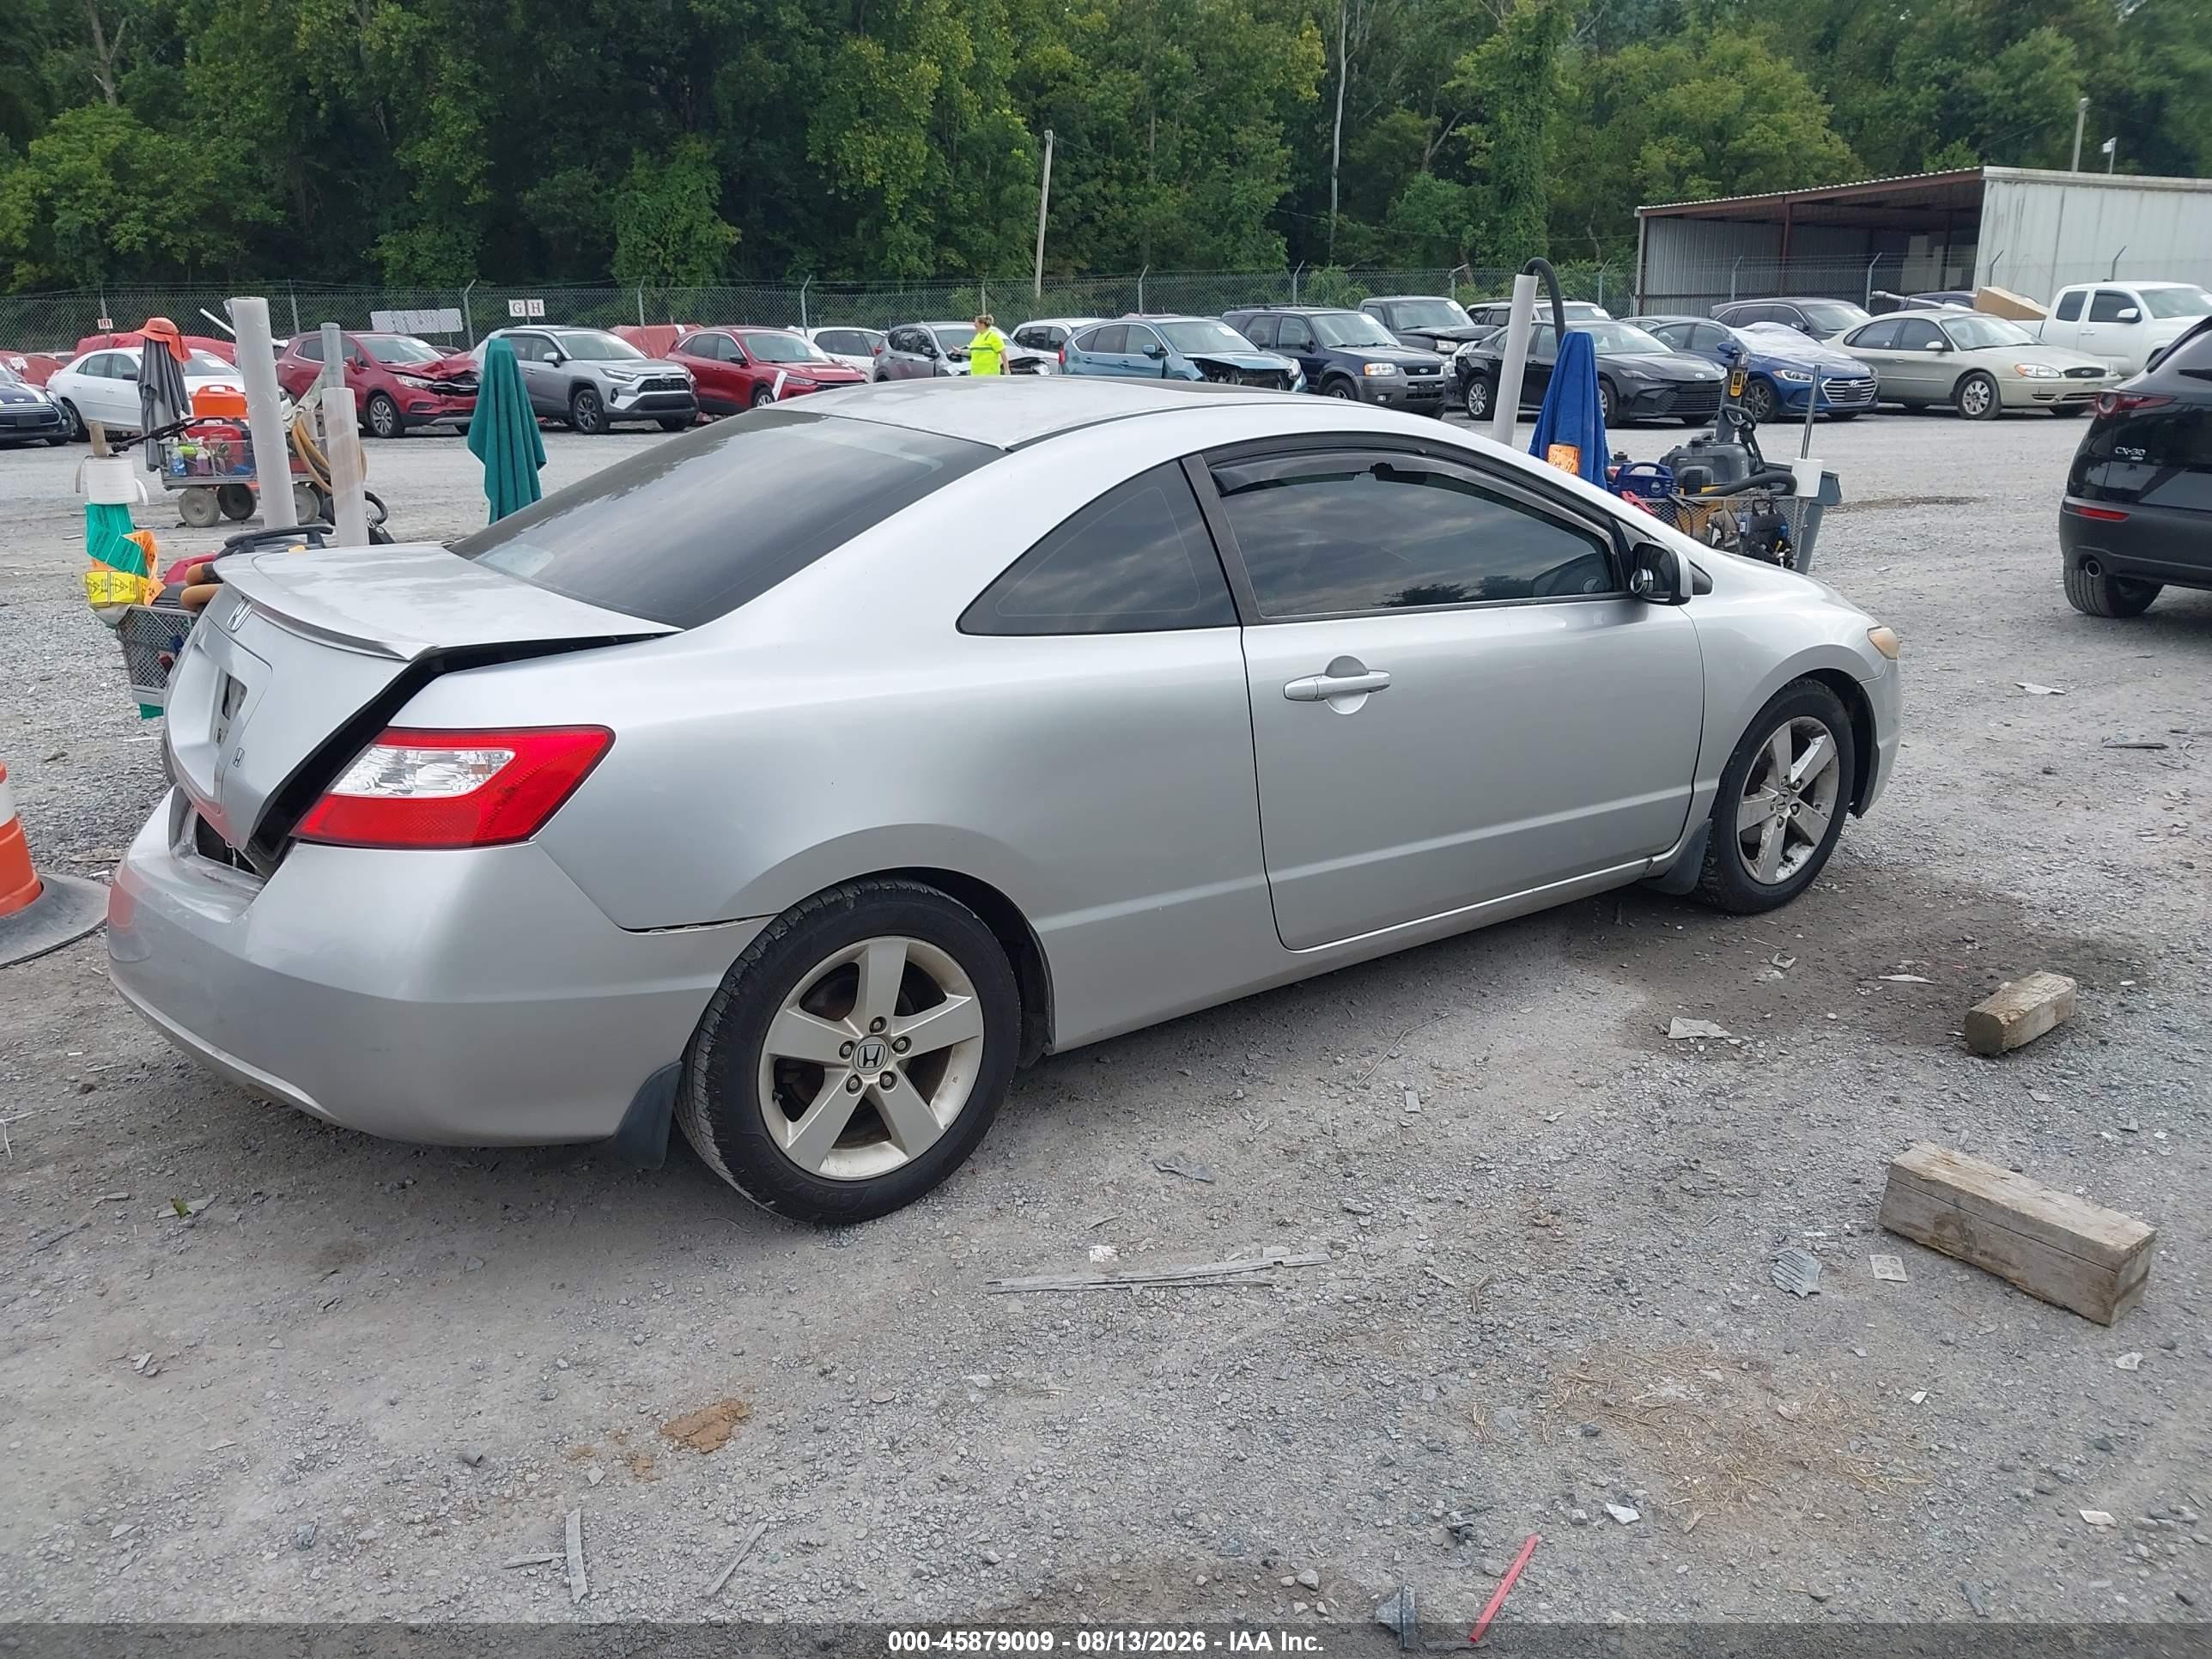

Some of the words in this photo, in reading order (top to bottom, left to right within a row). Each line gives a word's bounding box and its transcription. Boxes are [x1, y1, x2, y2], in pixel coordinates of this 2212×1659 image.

[513, 302, 522, 314] G
[532, 302, 541, 313] H
[2115, 447, 2146, 455] CX-30
